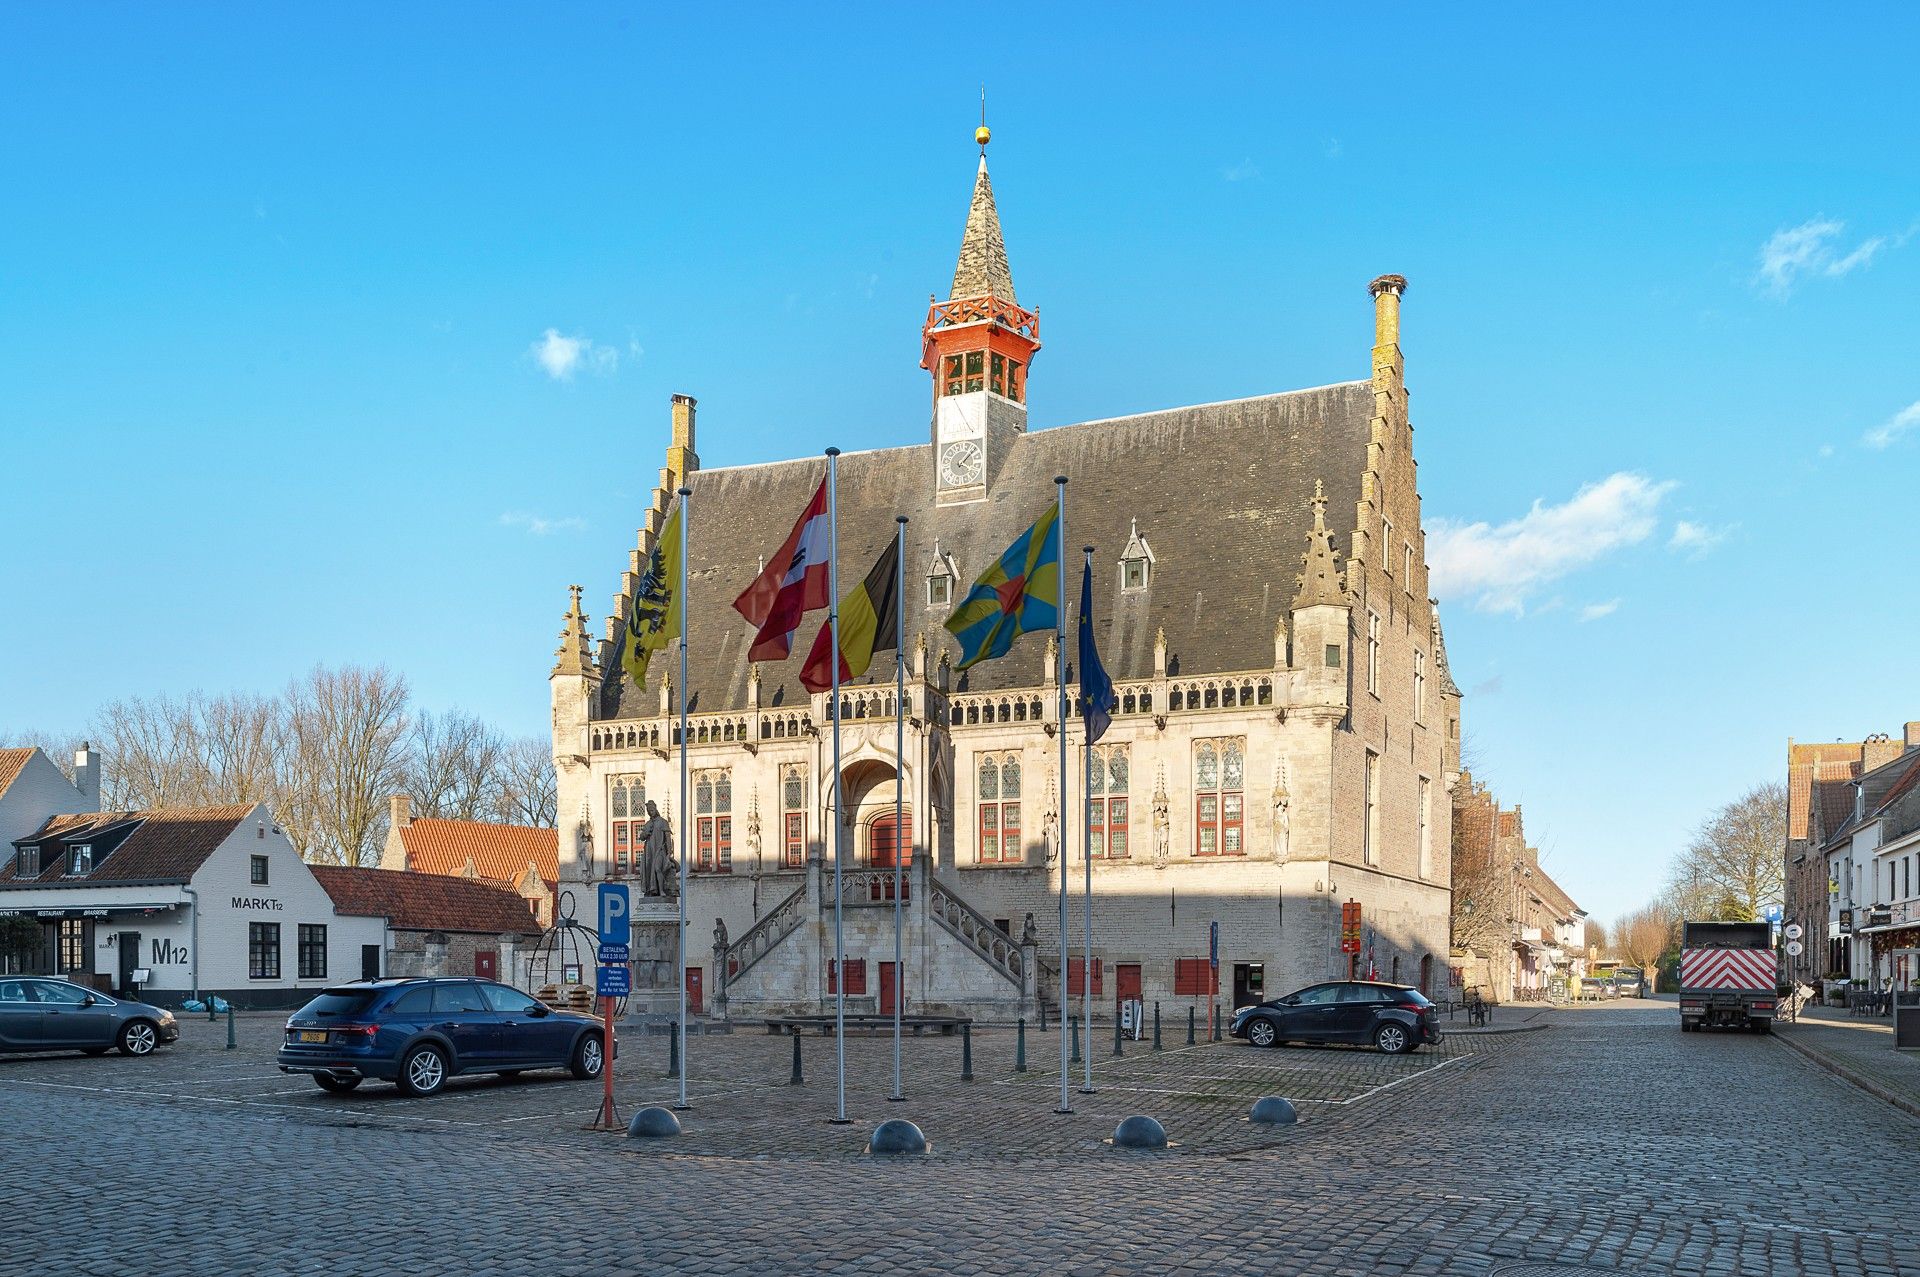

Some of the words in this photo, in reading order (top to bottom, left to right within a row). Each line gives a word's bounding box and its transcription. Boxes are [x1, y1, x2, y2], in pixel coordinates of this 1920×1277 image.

[604, 893, 625, 934] P
[1769, 906, 1778, 918] P
[152, 938, 188, 965] M12
